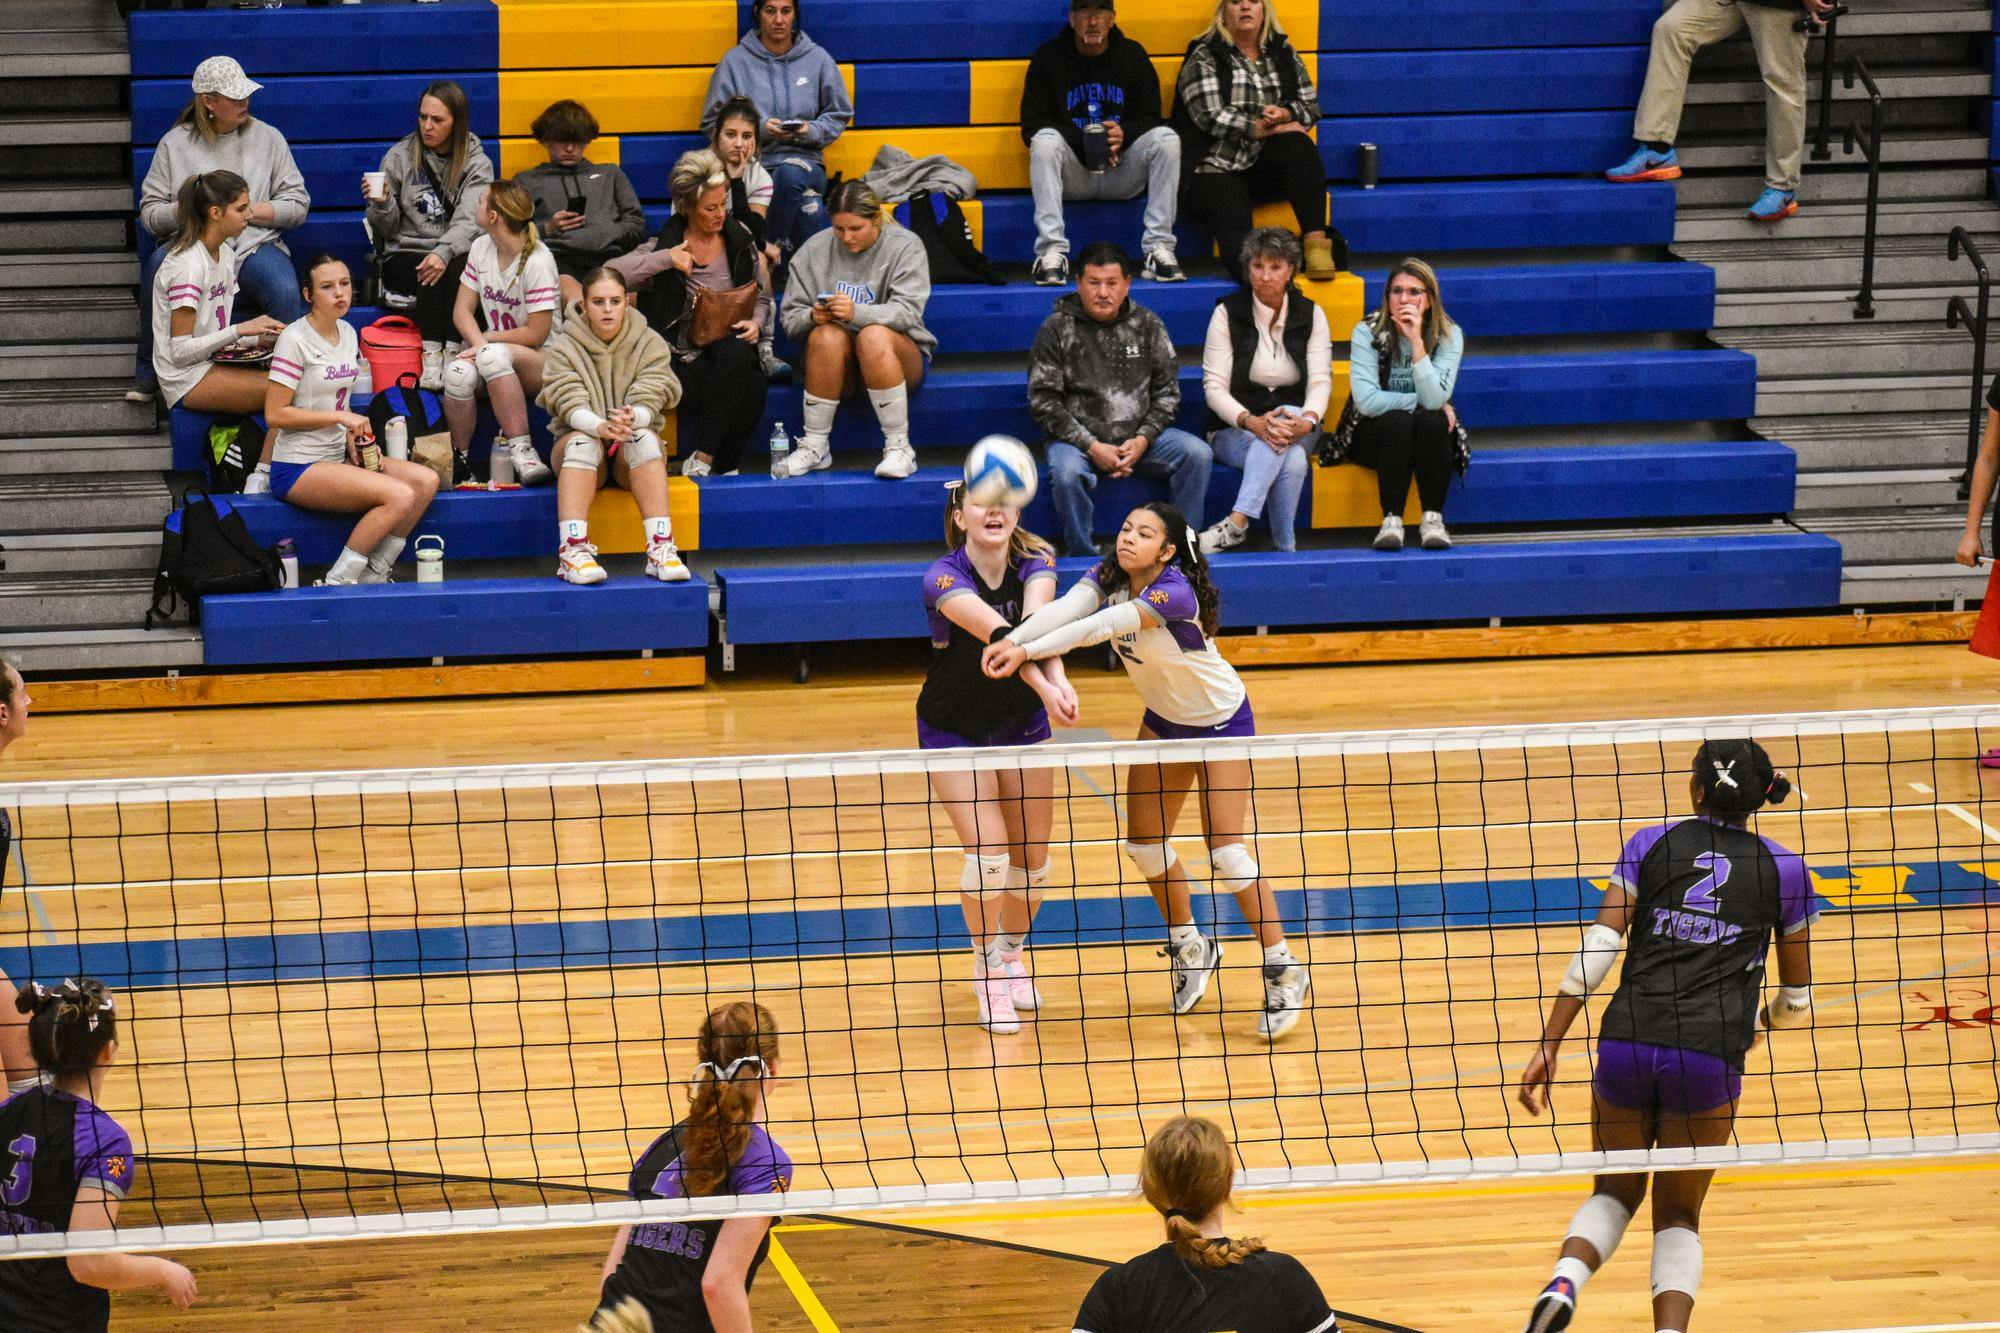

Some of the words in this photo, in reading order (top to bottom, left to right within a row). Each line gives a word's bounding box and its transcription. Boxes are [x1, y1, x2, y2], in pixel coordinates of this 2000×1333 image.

[216, 305, 226, 330] 1
[490, 309, 518, 331] 10
[324, 363, 359, 382] Bulldog
[335, 386, 348, 411] 2
[1682, 850, 1732, 914] 2
[1653, 907, 1743, 945] TIGERS
[0, 1133, 36, 1206] 3
